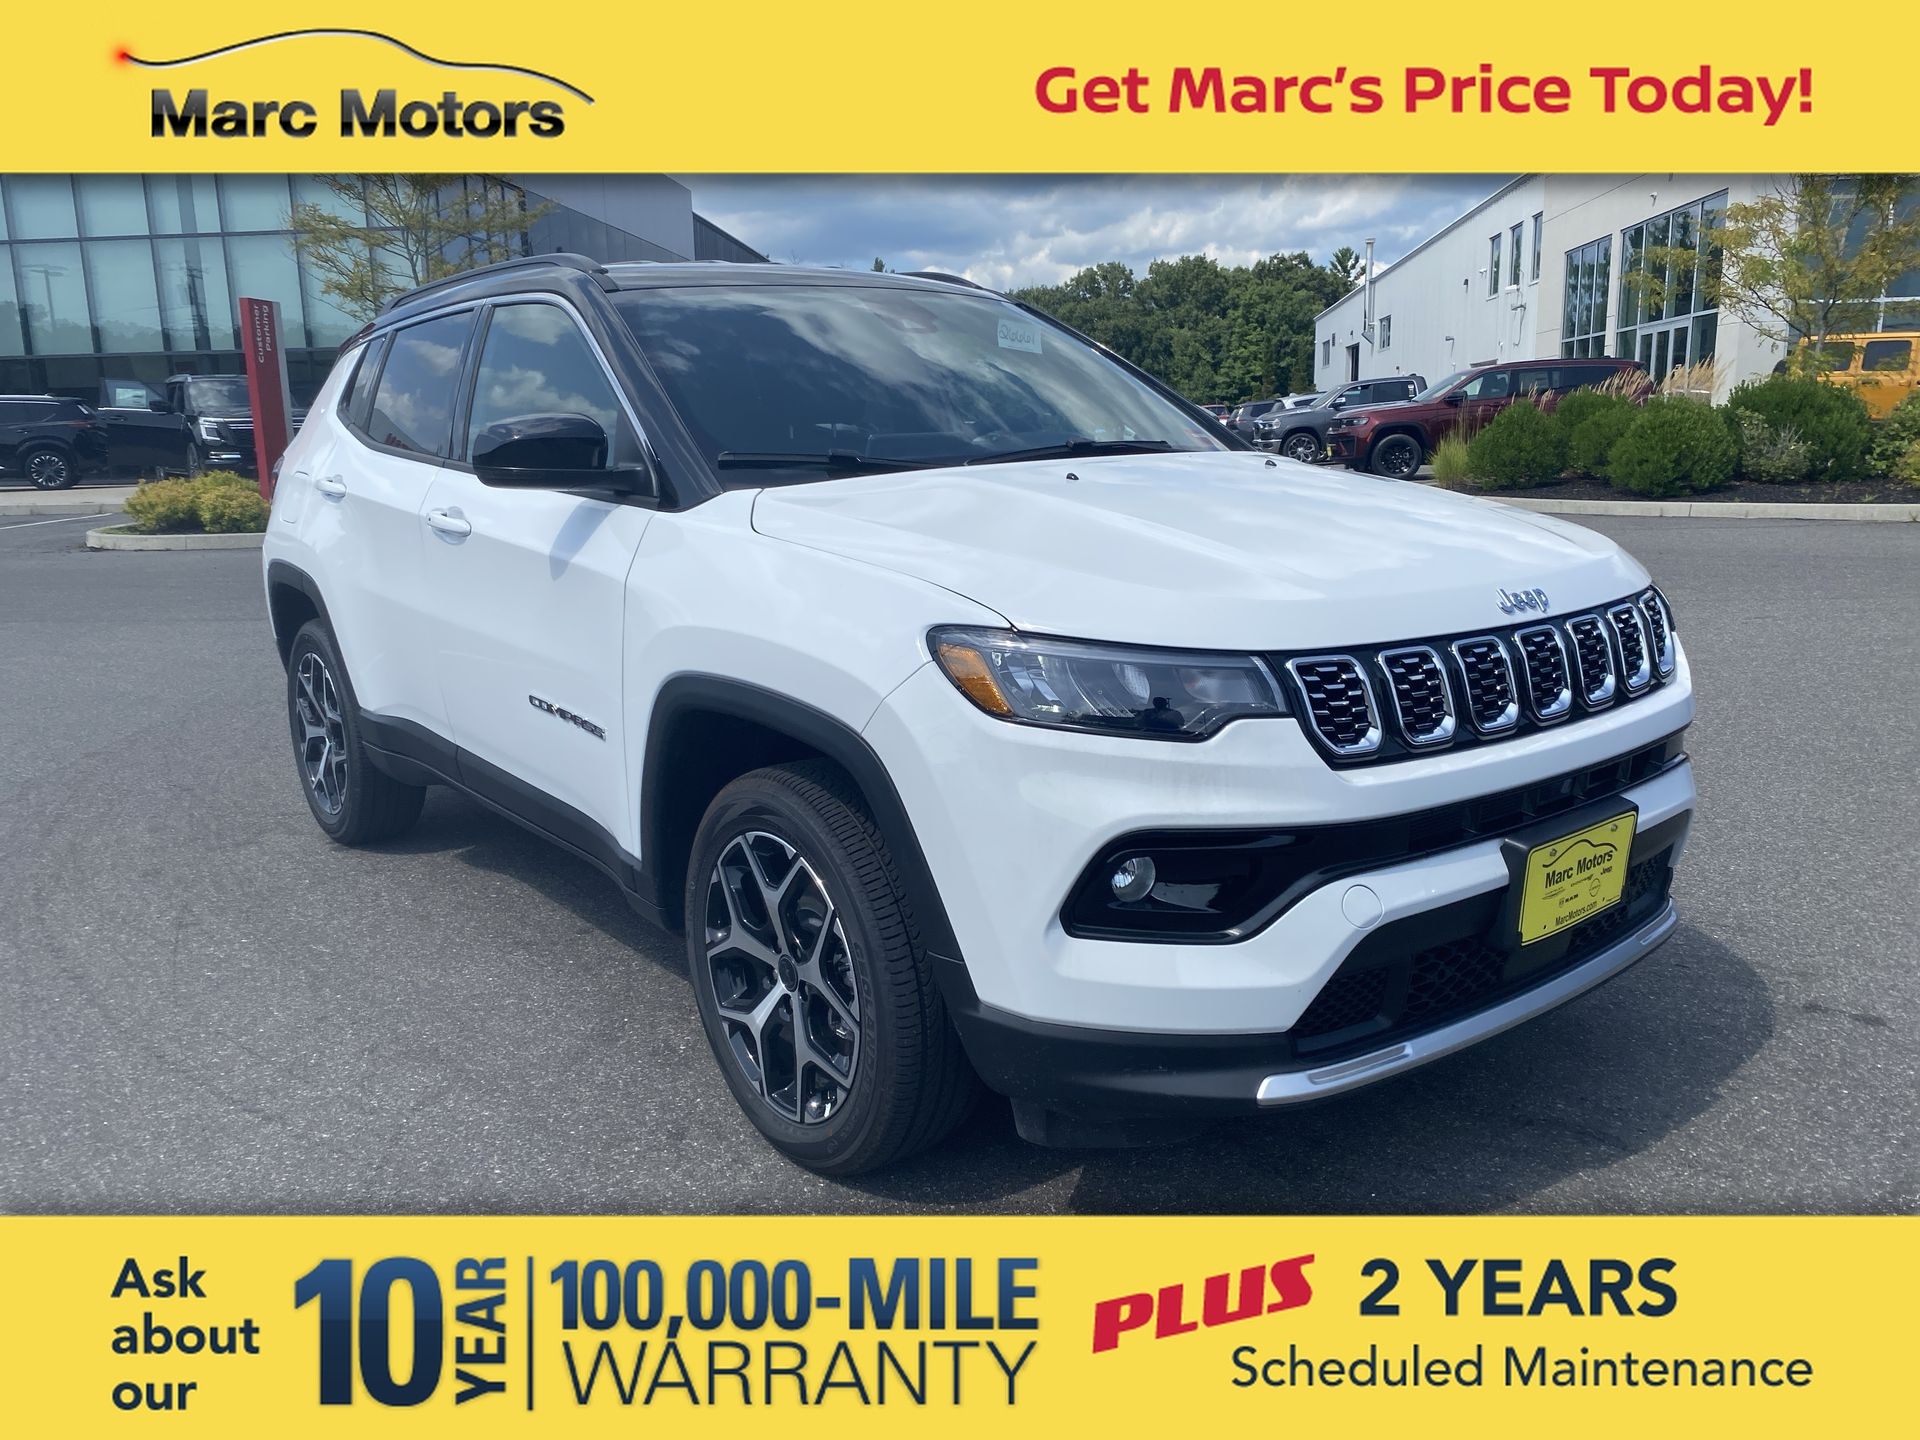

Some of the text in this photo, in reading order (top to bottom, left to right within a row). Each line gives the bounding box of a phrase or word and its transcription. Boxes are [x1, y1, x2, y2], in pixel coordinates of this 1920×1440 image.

[1496, 588, 1549, 615] Jeep
[1545, 867, 1574, 889] Marc
[1576, 850, 1614, 876] Motors
[1555, 901, 1598, 926] MarcMotors.com
